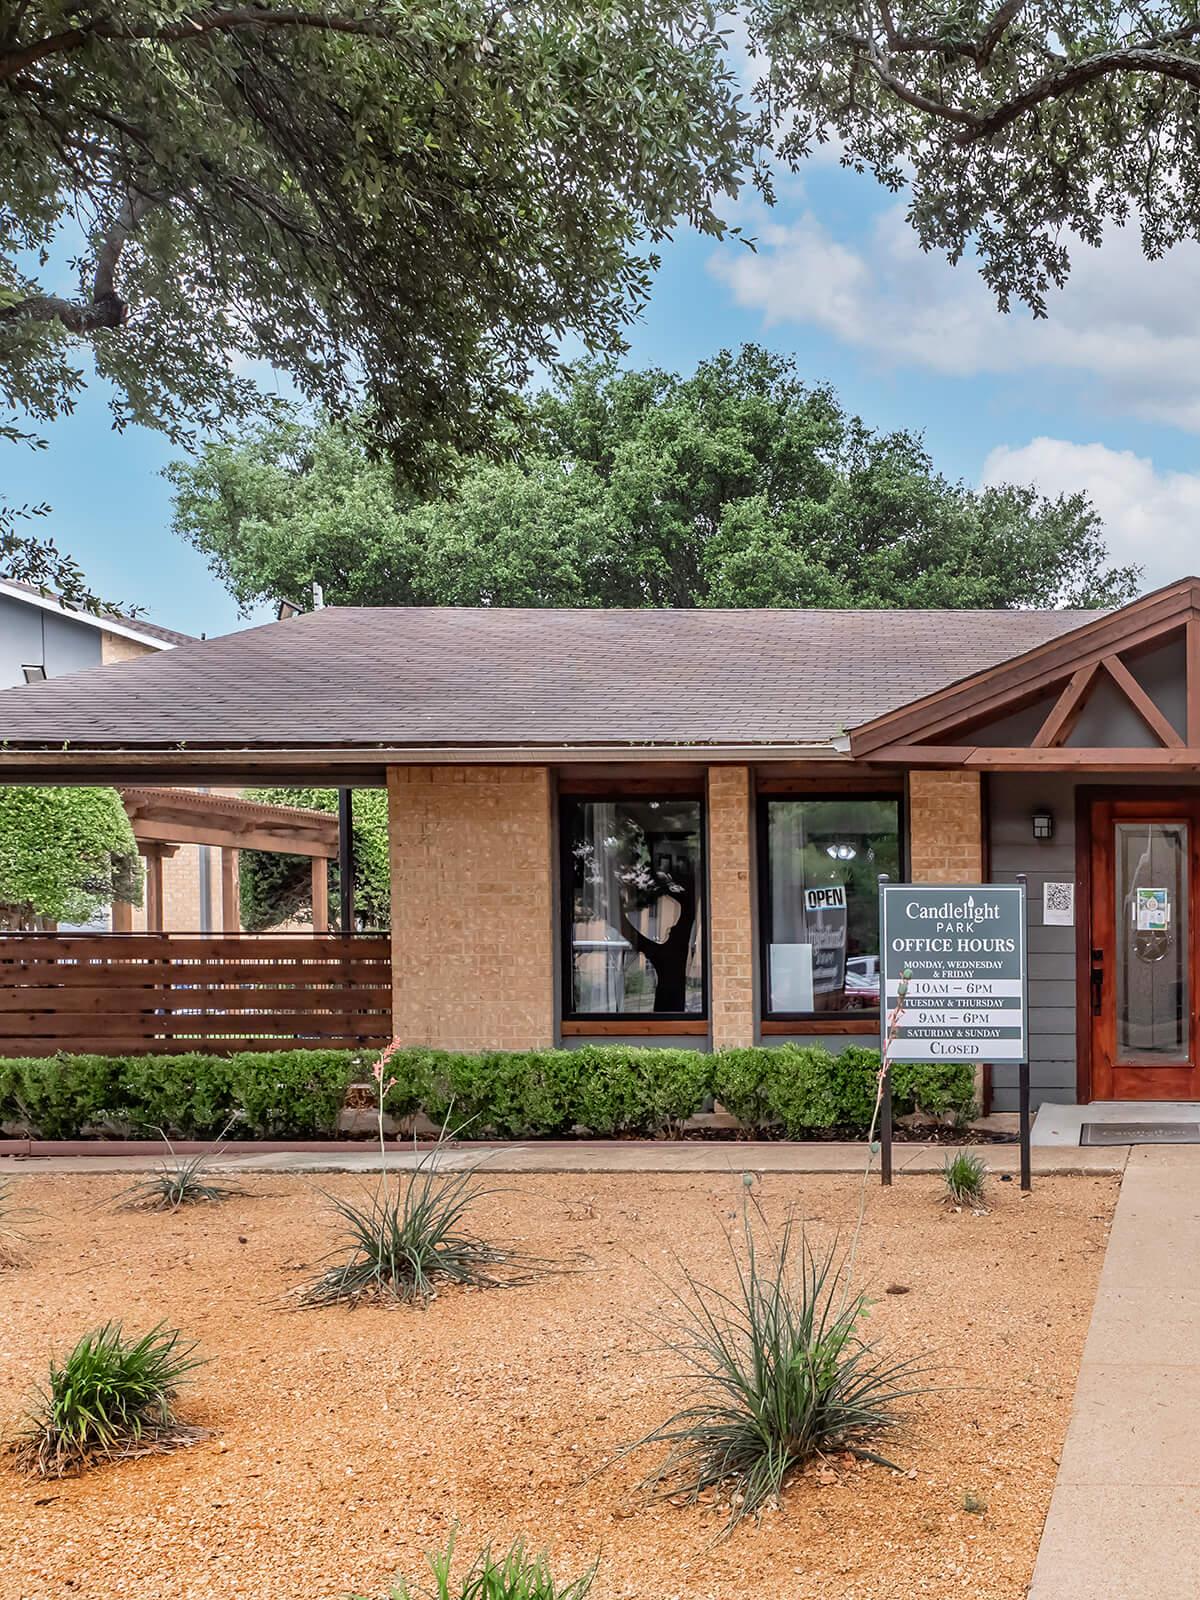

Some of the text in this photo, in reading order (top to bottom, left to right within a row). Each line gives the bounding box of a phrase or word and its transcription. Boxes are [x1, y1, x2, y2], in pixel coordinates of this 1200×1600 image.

[808, 888, 843, 908] OPEN
[906, 896, 1000, 923] Candlelight
[937, 922, 974, 932] PARK
[892, 938, 1015, 952] OFFICE HOURS
[904, 961, 1003, 970] MONDAY, WEDNESDAY
[916, 983, 949, 993] 10AM
[966, 983, 993, 993] 6PM
[919, 1013, 945, 1023] 9AM
[963, 1013, 989, 1023] 6PM
